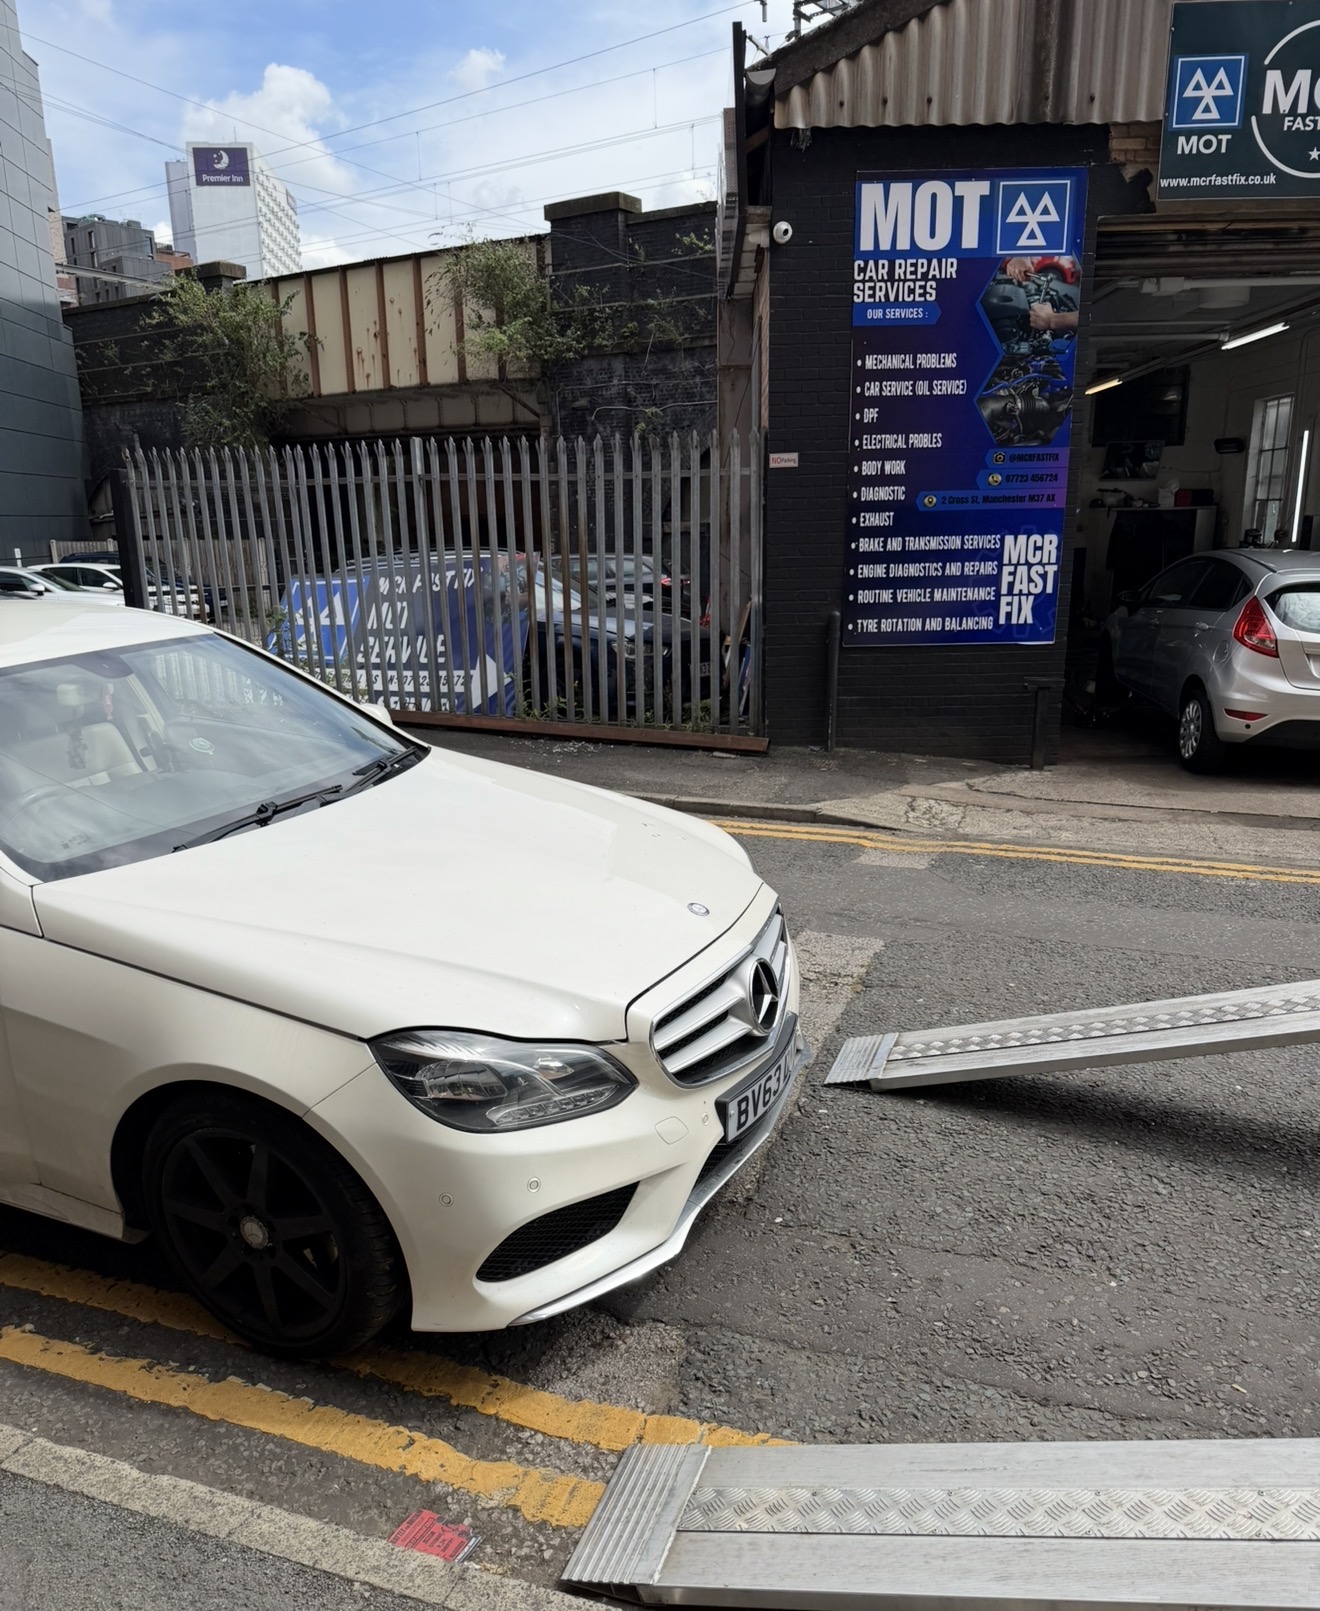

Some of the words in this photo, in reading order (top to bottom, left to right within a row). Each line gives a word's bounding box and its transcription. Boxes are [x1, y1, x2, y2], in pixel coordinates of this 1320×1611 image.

[1262, 69, 1320, 114] M
[1177, 135, 1232, 154] MOT
[202, 174, 231, 182] Premier
[1160, 173, 1276, 187] www.mcrfastfix.co.uk
[859, 180, 990, 251] MOT
[853, 259, 888, 281] CAR
[894, 258, 958, 279] REPAIR
[853, 281, 937, 303] SERVICES
[866, 309, 884, 319] OUR
[885, 308, 924, 319] SERVICES
[864, 356, 914, 370] MECHANICAL
[916, 354, 958, 368] PROBLEMS
[864, 383, 880, 396] CAR
[881, 382, 914, 396] SERVICE
[915, 381, 931, 396] (OIL
[932, 380, 968, 395] SERVICE)
[863, 408, 879, 422] DPF
[862, 435, 908, 449] ELECTRICAL
[908, 434, 942, 447] PROBLES
[861, 462, 883, 475] BODY
[884, 461, 906, 474] WORK
[1005, 474, 1029, 483] 07723
[1030, 474, 1058, 483] 456724
[860, 487, 906, 501] DIAGNOSTIC
[948, 496, 969, 504] Cross
[982, 494, 1026, 503] Manchester
[1028, 494, 1044, 503] M37
[1046, 494, 1056, 502] AX
[860, 512, 894, 526] EXHAUST
[859, 538, 884, 552] BRAKE
[886, 537, 903, 550] AND
[904, 536, 962, 550] TRANSMISSION
[963, 535, 1001, 549] SERVICES
[1002, 534, 1058, 564] MCR
[858, 564, 888, 578] ENGINE
[888, 563, 943, 577] DIAGNOSTICS
[944, 562, 962, 576] AND
[964, 561, 998, 575] REPAIRS
[1000, 565, 1058, 595] FAST
[857, 590, 894, 604] ROUTINE
[896, 589, 932, 602] VEHICLE
[933, 587, 996, 602] MAINTENANCE
[998, 596, 1034, 625] FIX
[856, 619, 879, 632] TYRE
[880, 618, 923, 632] ROTATION
[924, 617, 943, 630] AND
[944, 616, 994, 632] BALANCING
[737, 1065, 782, 1132] BV63
